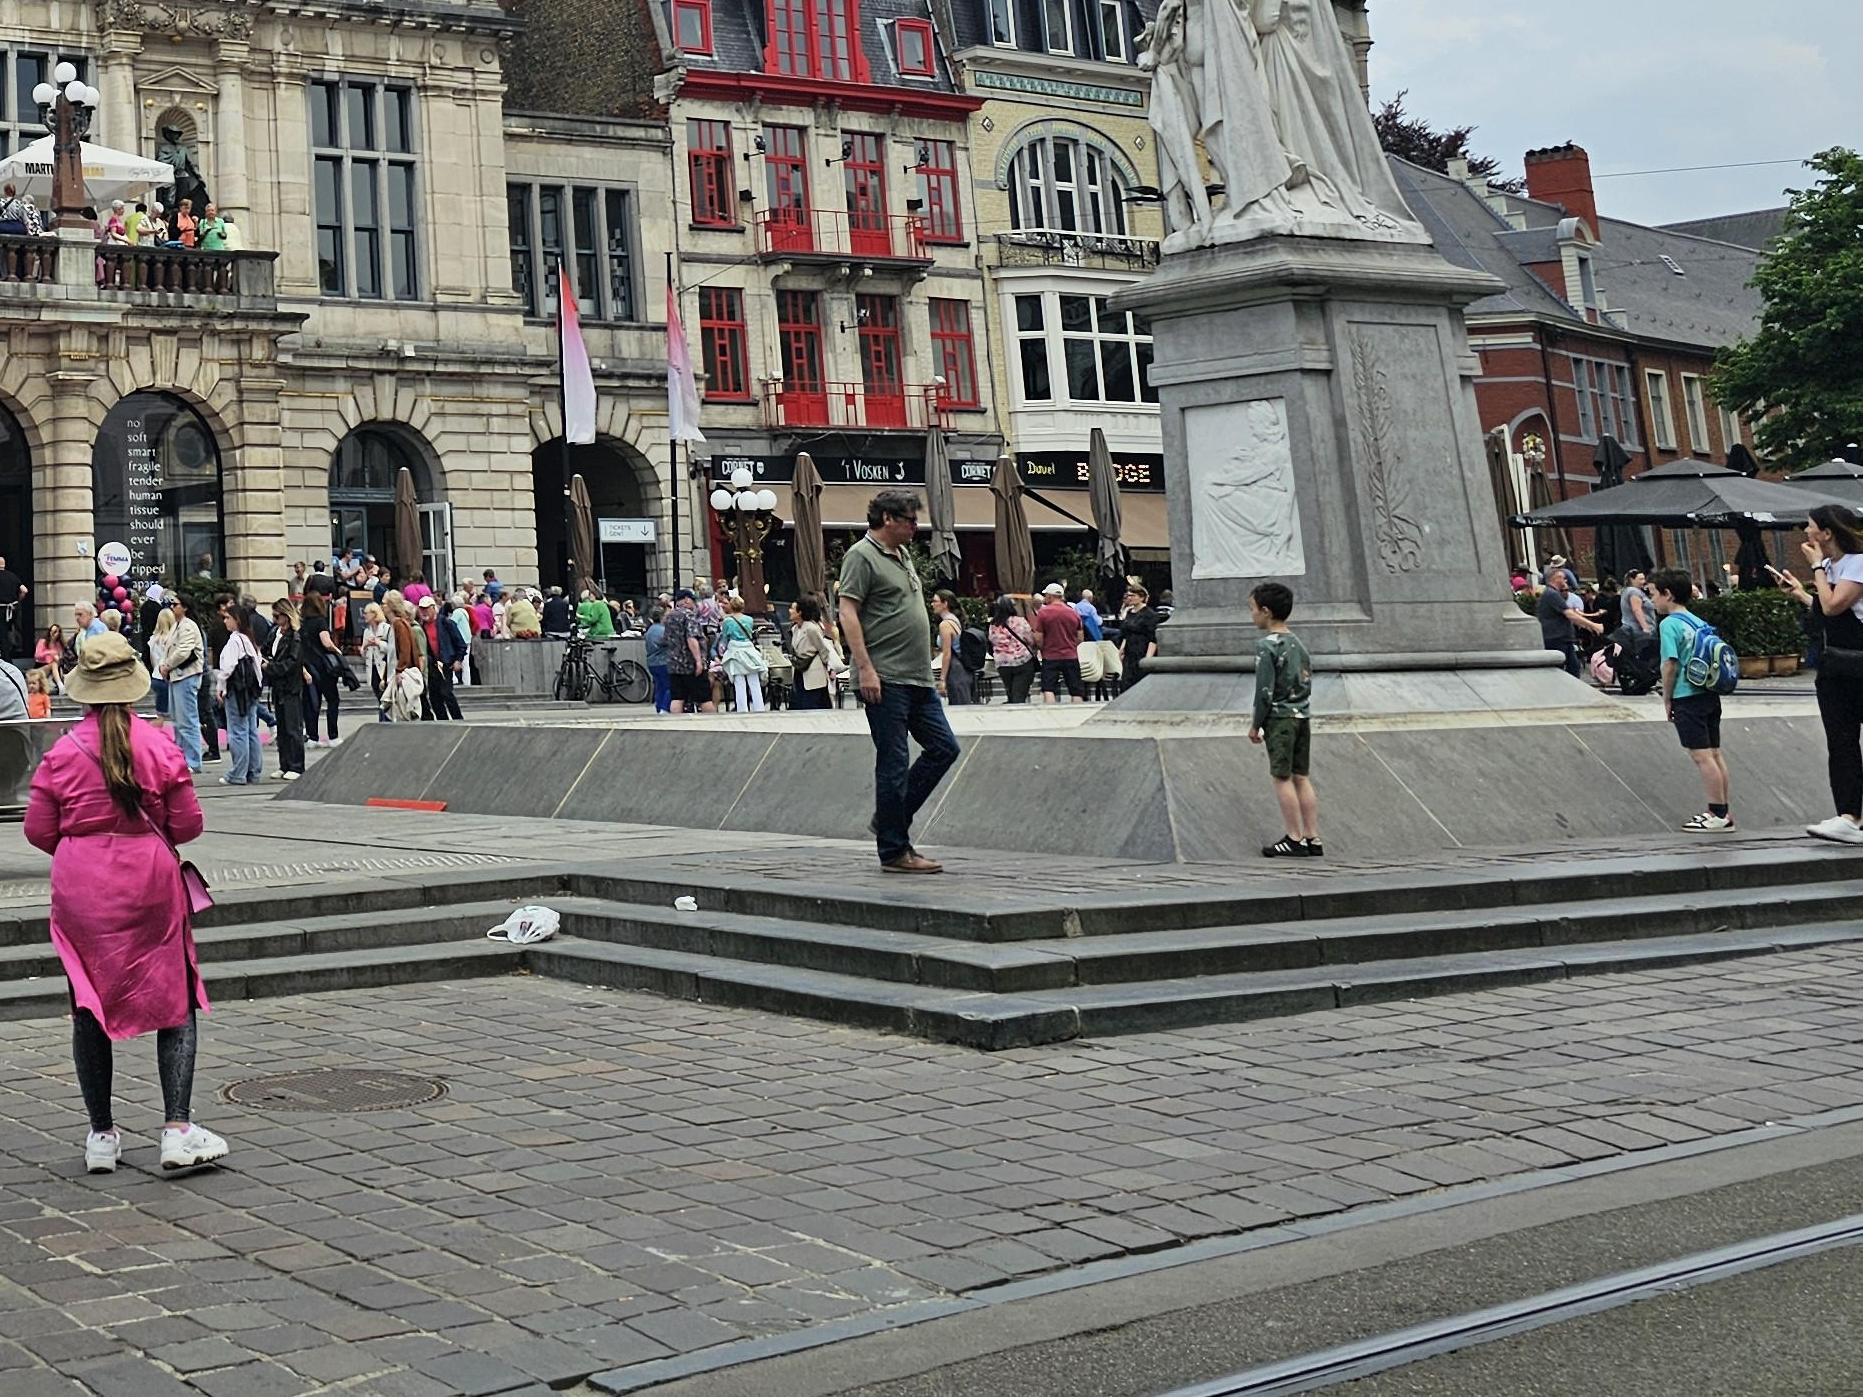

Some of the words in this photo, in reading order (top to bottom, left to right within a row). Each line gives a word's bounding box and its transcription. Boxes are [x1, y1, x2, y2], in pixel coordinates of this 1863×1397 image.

[127, 420, 140, 428] no
[127, 432, 147, 442] soft
[127, 448, 156, 457] smart
[128, 461, 161, 474] fragile
[961, 464, 992, 479] CORNET
[1026, 460, 1056, 475] Duvel
[129, 476, 164, 486] tender
[129, 490, 162, 500] human
[130, 506, 159, 515] tissue
[130, 519, 164, 530] should
[130, 536, 155, 544] ever
[131, 549, 144, 559] be
[131, 563, 166, 576] ripped
